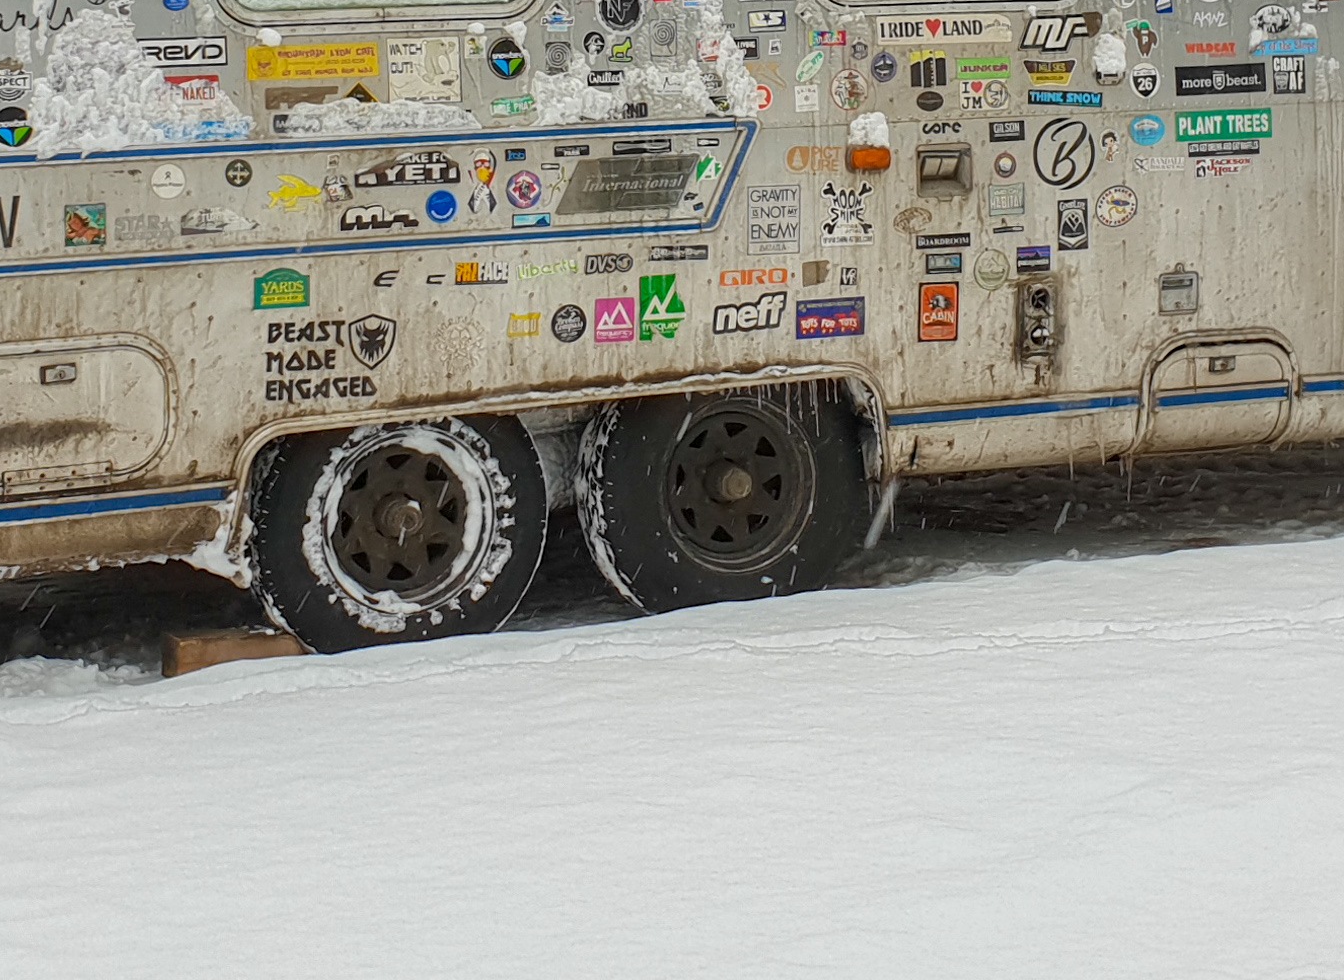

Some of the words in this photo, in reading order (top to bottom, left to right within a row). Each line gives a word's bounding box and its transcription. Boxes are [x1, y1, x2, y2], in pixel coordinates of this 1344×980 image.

[889, 21, 924, 37] RIDE
[943, 19, 983, 36] LAND
[1185, 42, 1236, 55] WILDCAT
[1273, 57, 1304, 71] CRAFT
[1137, 77, 1153, 91] 26
[1182, 78, 1211, 90] more
[1029, 91, 1062, 103] THINK
[1065, 92, 1101, 104] SNOW
[1179, 114, 1223, 137] PLANT
[1226, 112, 1270, 134] TREES
[1207, 159, 1251, 171] JACKSON
[1214, 166, 1239, 177] HOLE
[582, 176, 683, 193] International
[750, 188, 798, 203] GRAVITY
[761, 206, 786, 219] NOT
[750, 222, 799, 239] ENEMY
[917, 236, 969, 246] BOARDROOM
[587, 256, 617, 273] DVS
[720, 268, 788, 287] GIRO
[262, 281, 304, 294] YARDS
[716, 294, 785, 332] neff
[922, 311, 956, 324] CABIN
[267, 320, 346, 347] BEAST
[265, 349, 337, 375] MODE
[265, 375, 378, 404] ENGAGED
